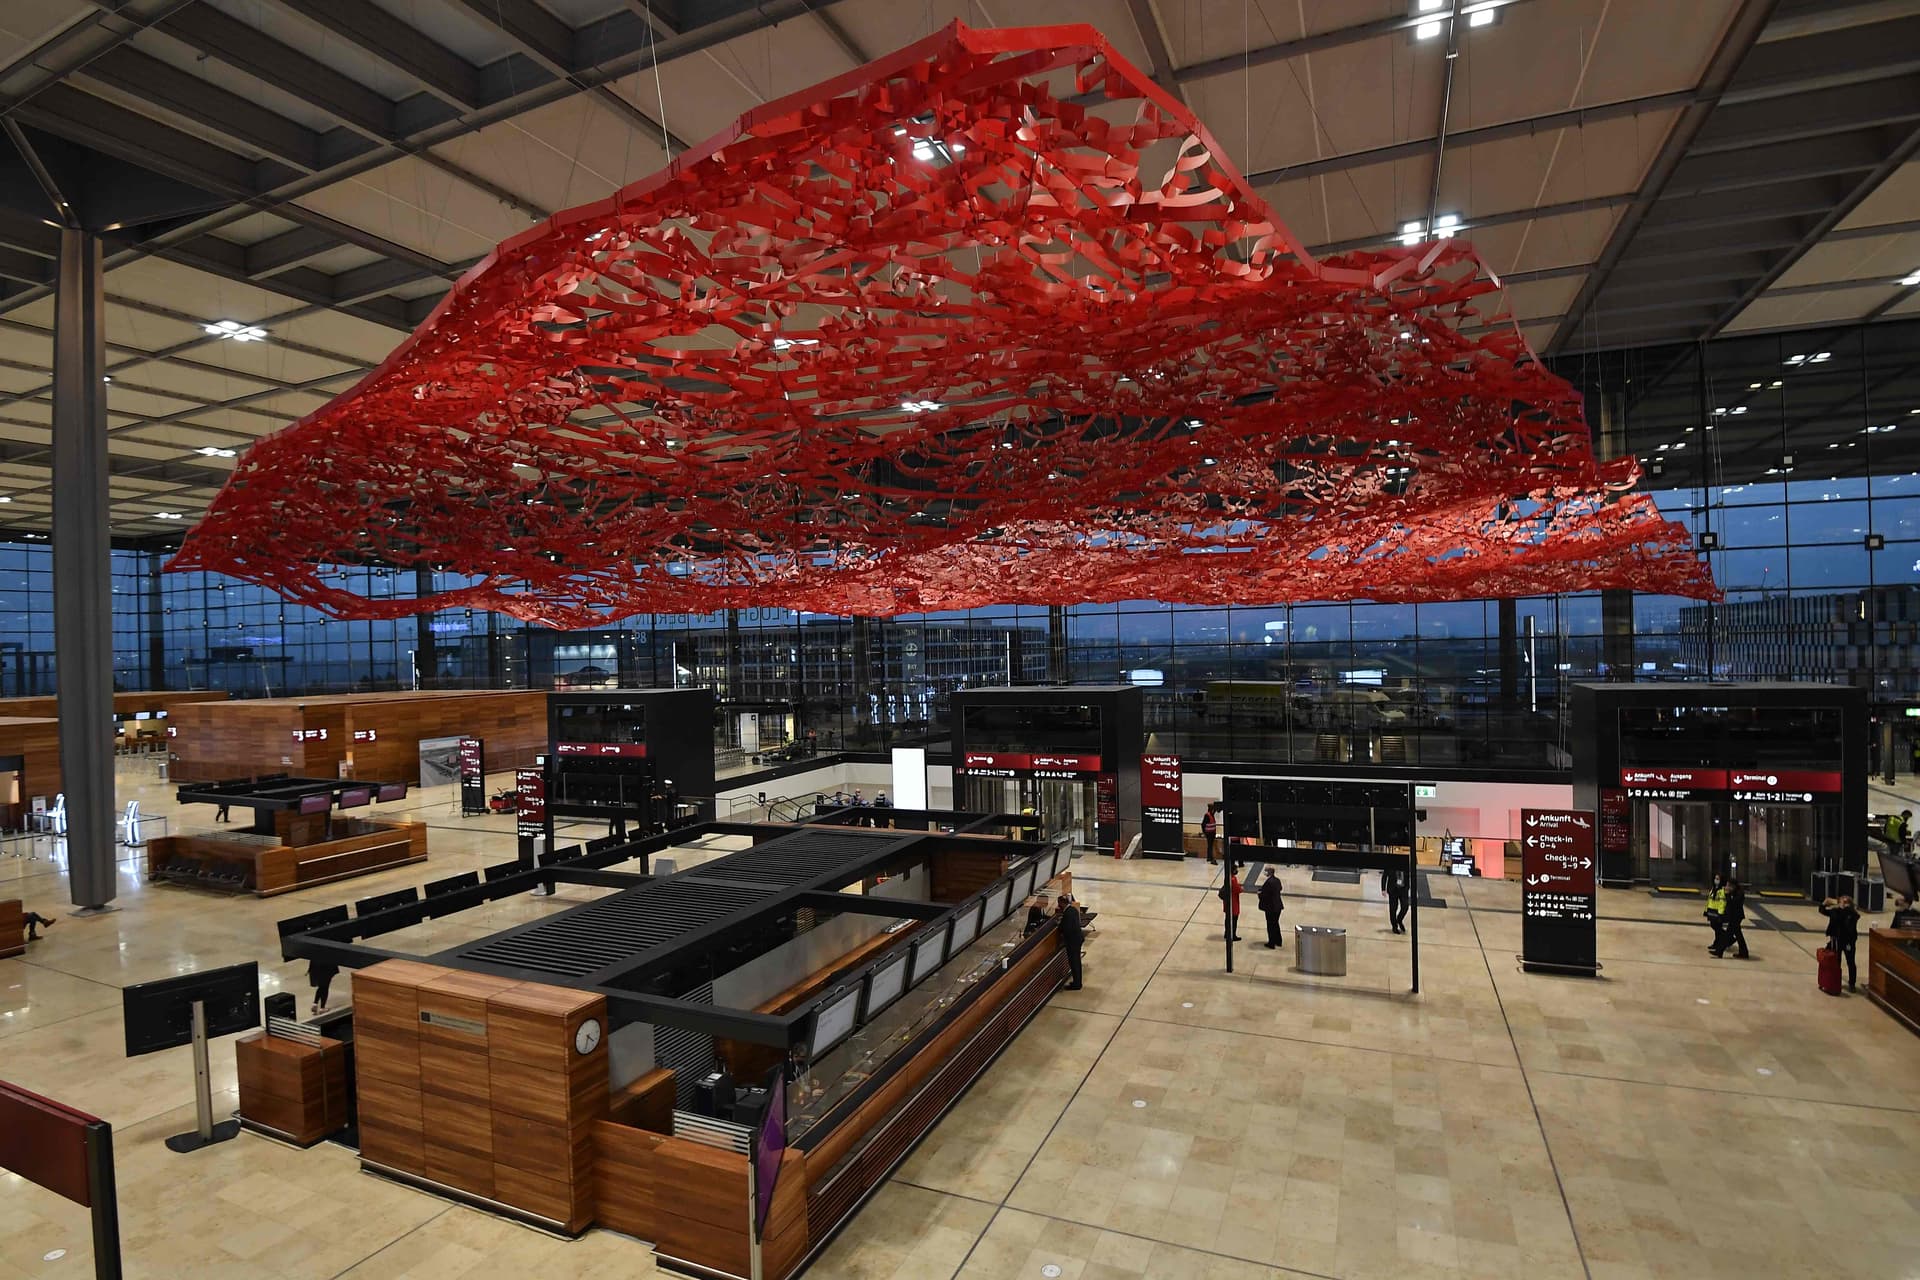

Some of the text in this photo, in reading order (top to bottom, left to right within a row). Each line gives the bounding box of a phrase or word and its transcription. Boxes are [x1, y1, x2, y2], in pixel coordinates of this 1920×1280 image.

[319, 728, 327, 740] 3
[368, 729, 376, 741] 3
[1539, 814, 1572, 823] Ankunft
[1540, 834, 1573, 843] Check-in
[1544, 853, 1578, 862] Check-in
